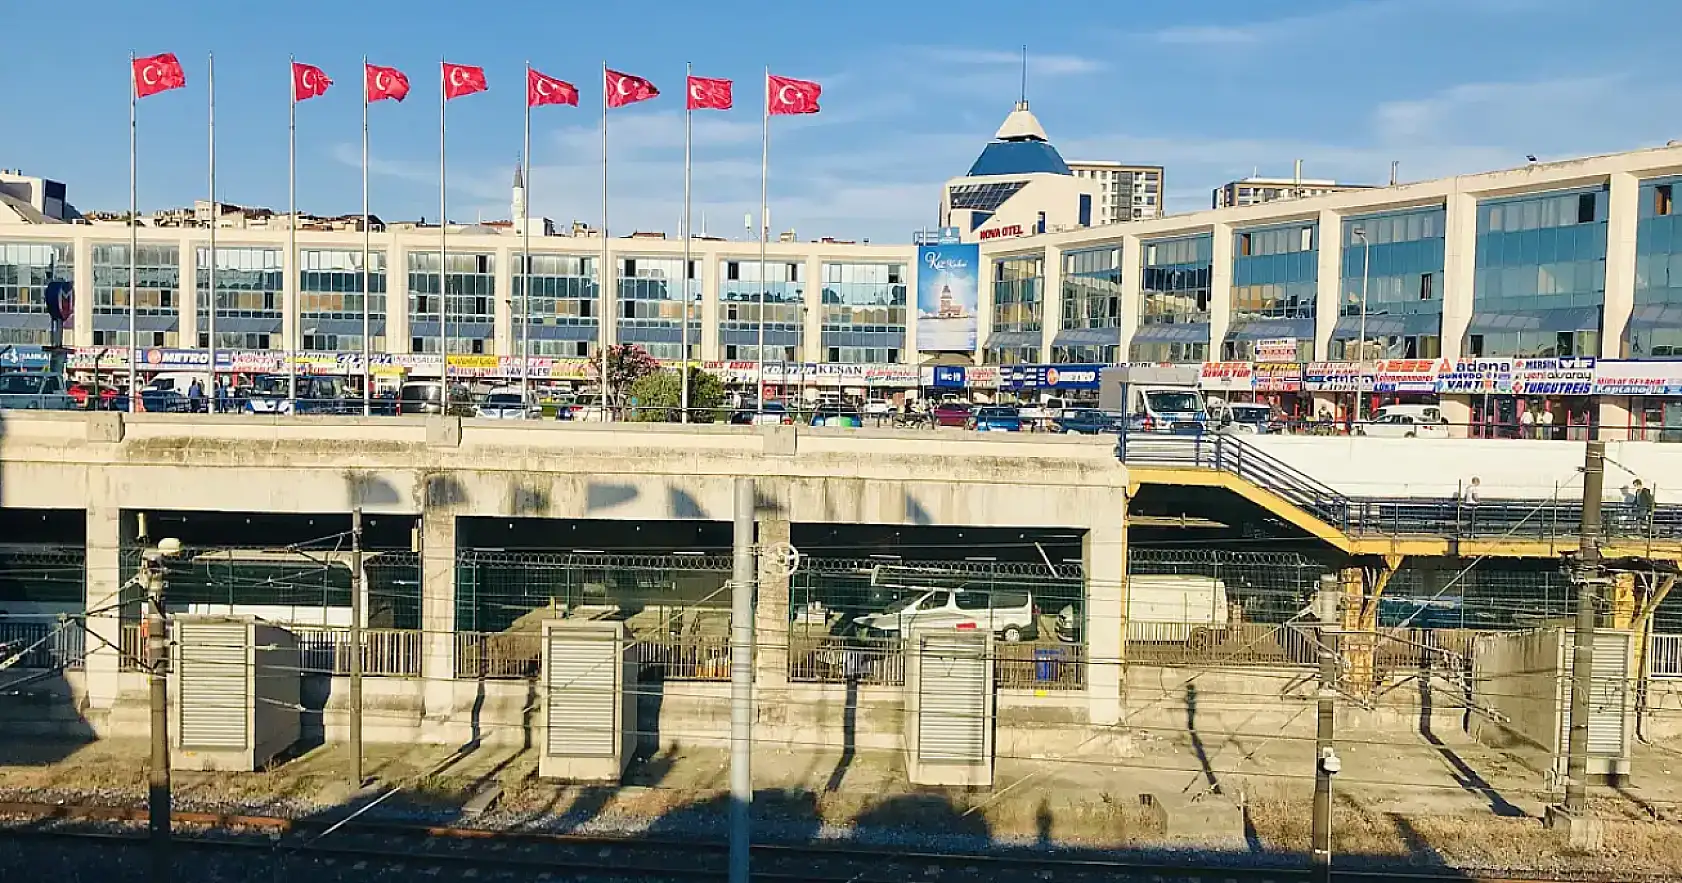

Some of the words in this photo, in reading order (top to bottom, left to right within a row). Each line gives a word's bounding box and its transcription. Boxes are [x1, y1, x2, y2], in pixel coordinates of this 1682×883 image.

[980, 228, 1001, 240] NOVA
[1002, 224, 1024, 237] OTEL
[162, 352, 209, 364] METRO
[1386, 360, 1434, 372] SES
[1456, 359, 1510, 372] adana
